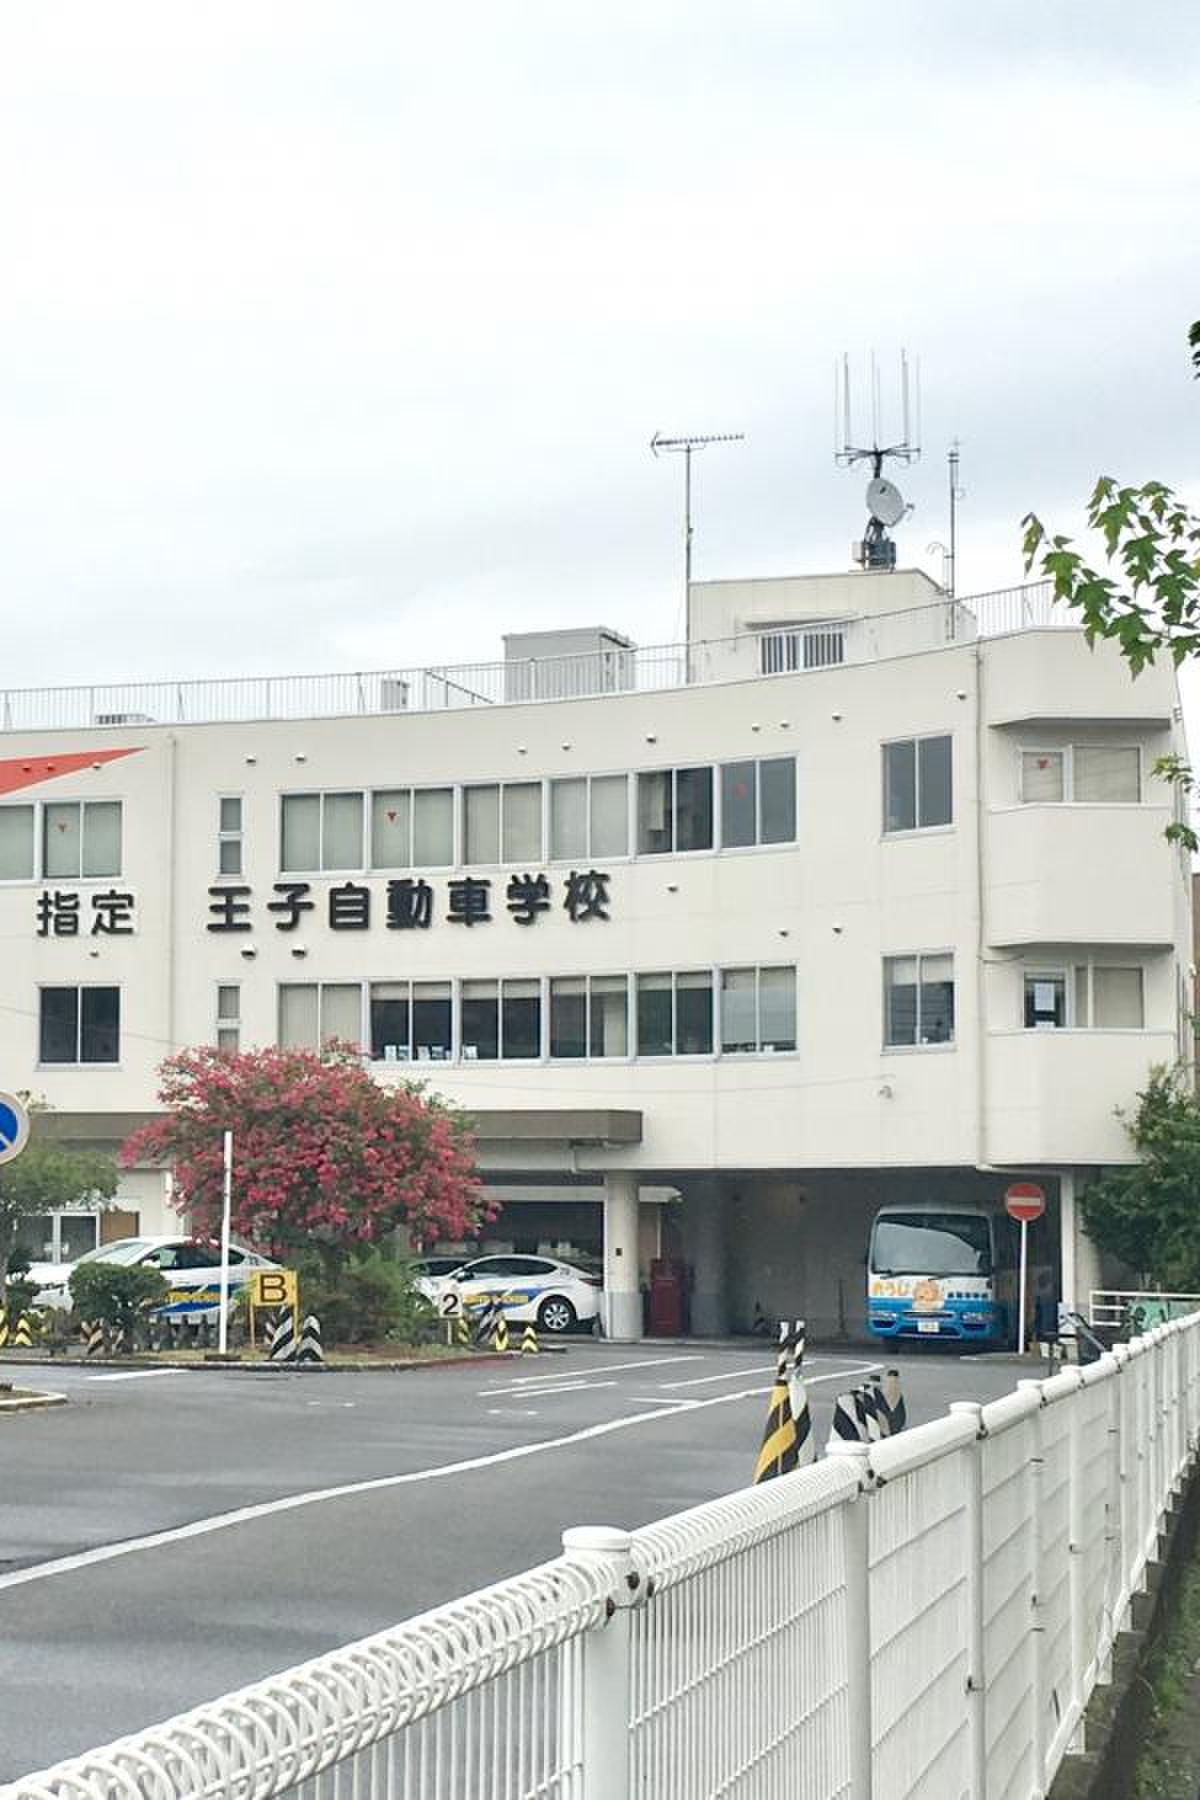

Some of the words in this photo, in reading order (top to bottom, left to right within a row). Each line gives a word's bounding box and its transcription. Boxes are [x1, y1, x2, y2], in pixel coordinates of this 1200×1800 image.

[37, 889, 133, 938] 指定
[207, 870, 611, 932] 王子自動車学校
[259, 1273, 288, 1304] B
[442, 1293, 460, 1315] 2
